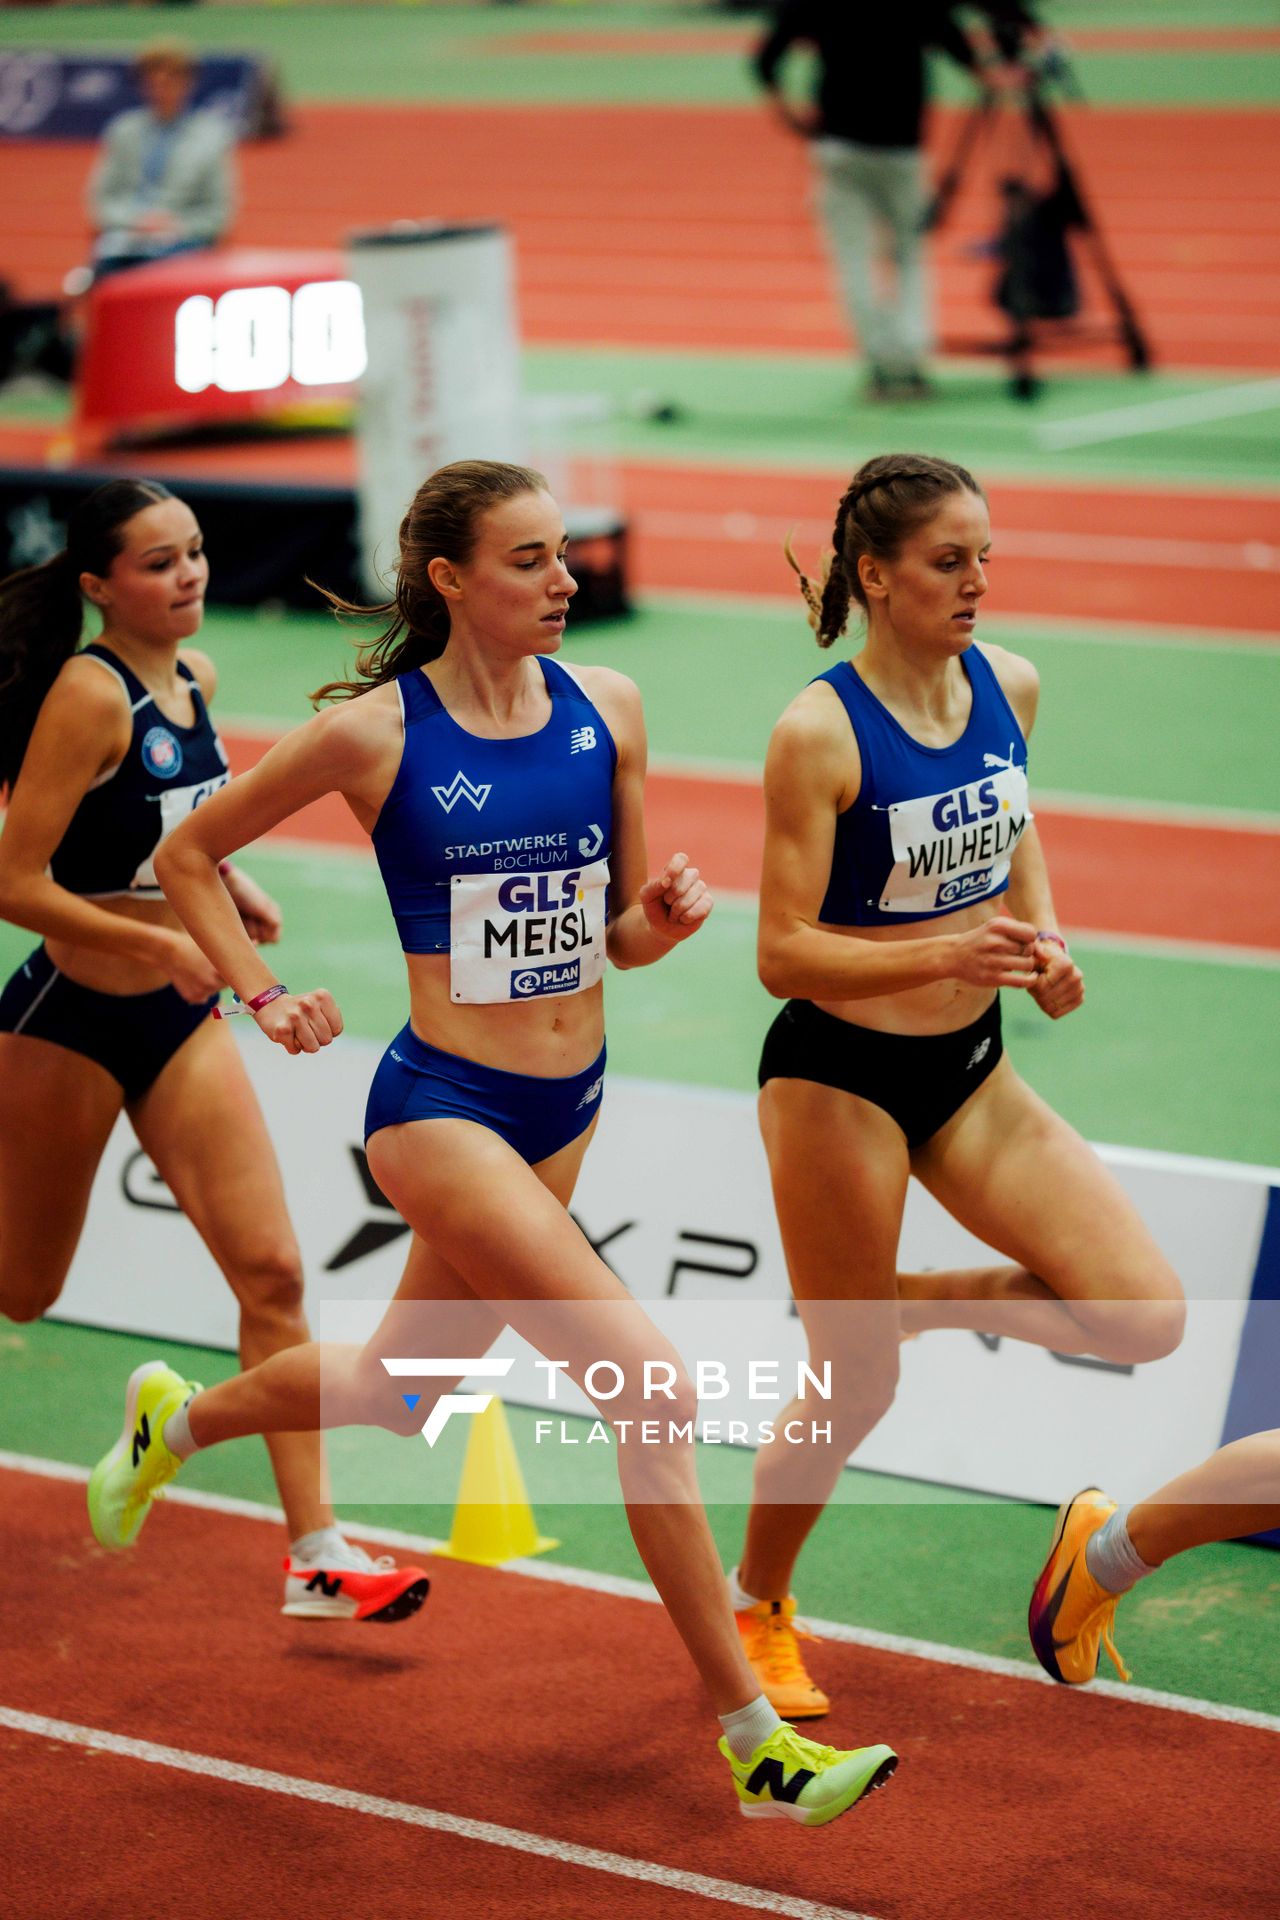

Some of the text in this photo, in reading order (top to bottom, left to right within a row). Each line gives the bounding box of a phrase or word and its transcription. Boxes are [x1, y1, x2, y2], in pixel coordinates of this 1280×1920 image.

[444, 832, 568, 860] STADTWERKE
[907, 814, 1026, 878] WILHELM
[494, 850, 568, 871] BOCHUM
[484, 908, 593, 959] MEISL
[543, 964, 579, 984] PLAN
